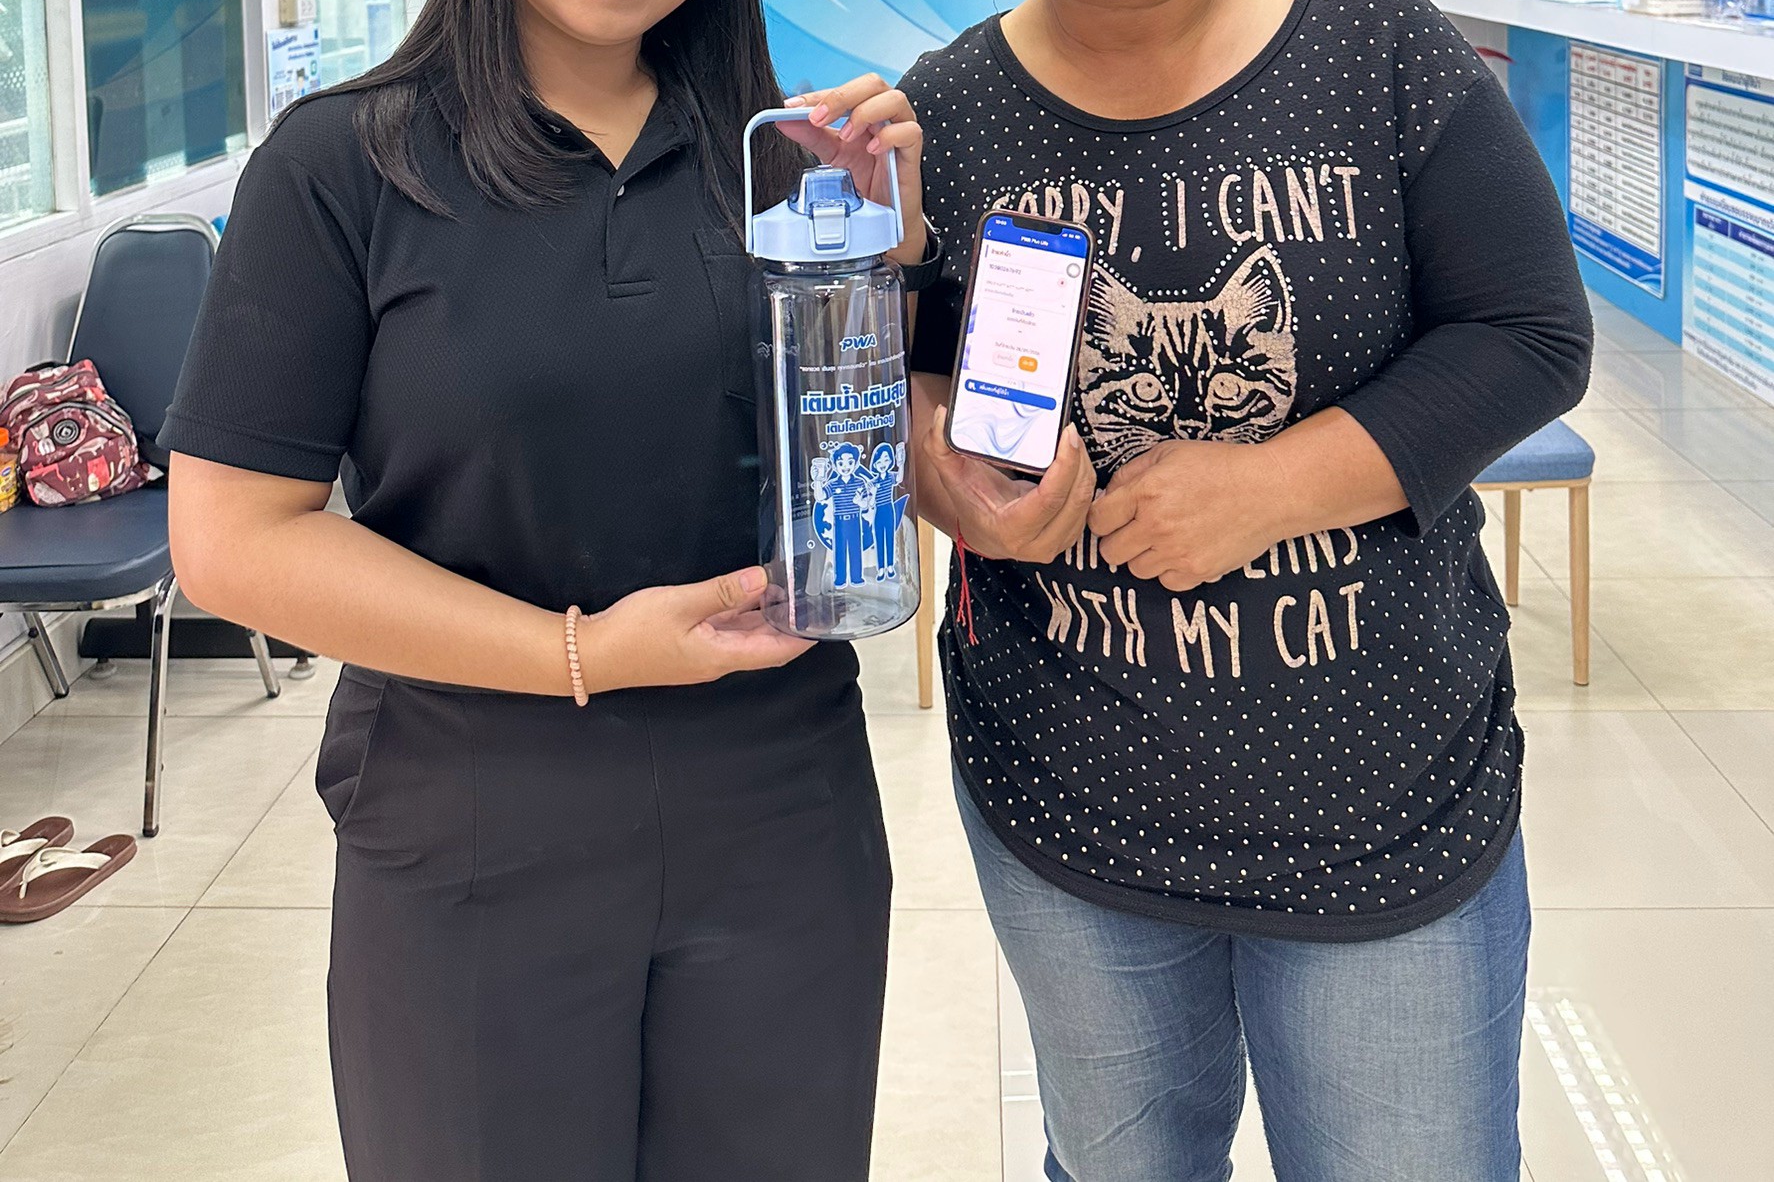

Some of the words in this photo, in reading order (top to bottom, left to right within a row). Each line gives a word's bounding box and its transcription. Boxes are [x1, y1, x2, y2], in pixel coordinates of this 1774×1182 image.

[1218, 164, 1360, 242] CAN'T
[840, 333, 877, 352] PWA
[801, 384, 861, 414] เติมน้ำ
[862, 378, 907, 410] เติมสุข
[826, 410, 895, 435] เติมโลกให้น่าอยู่
[1035, 571, 1147, 667] WITH
[1171, 598, 1240, 678] MY
[1273, 581, 1364, 668] CAT
